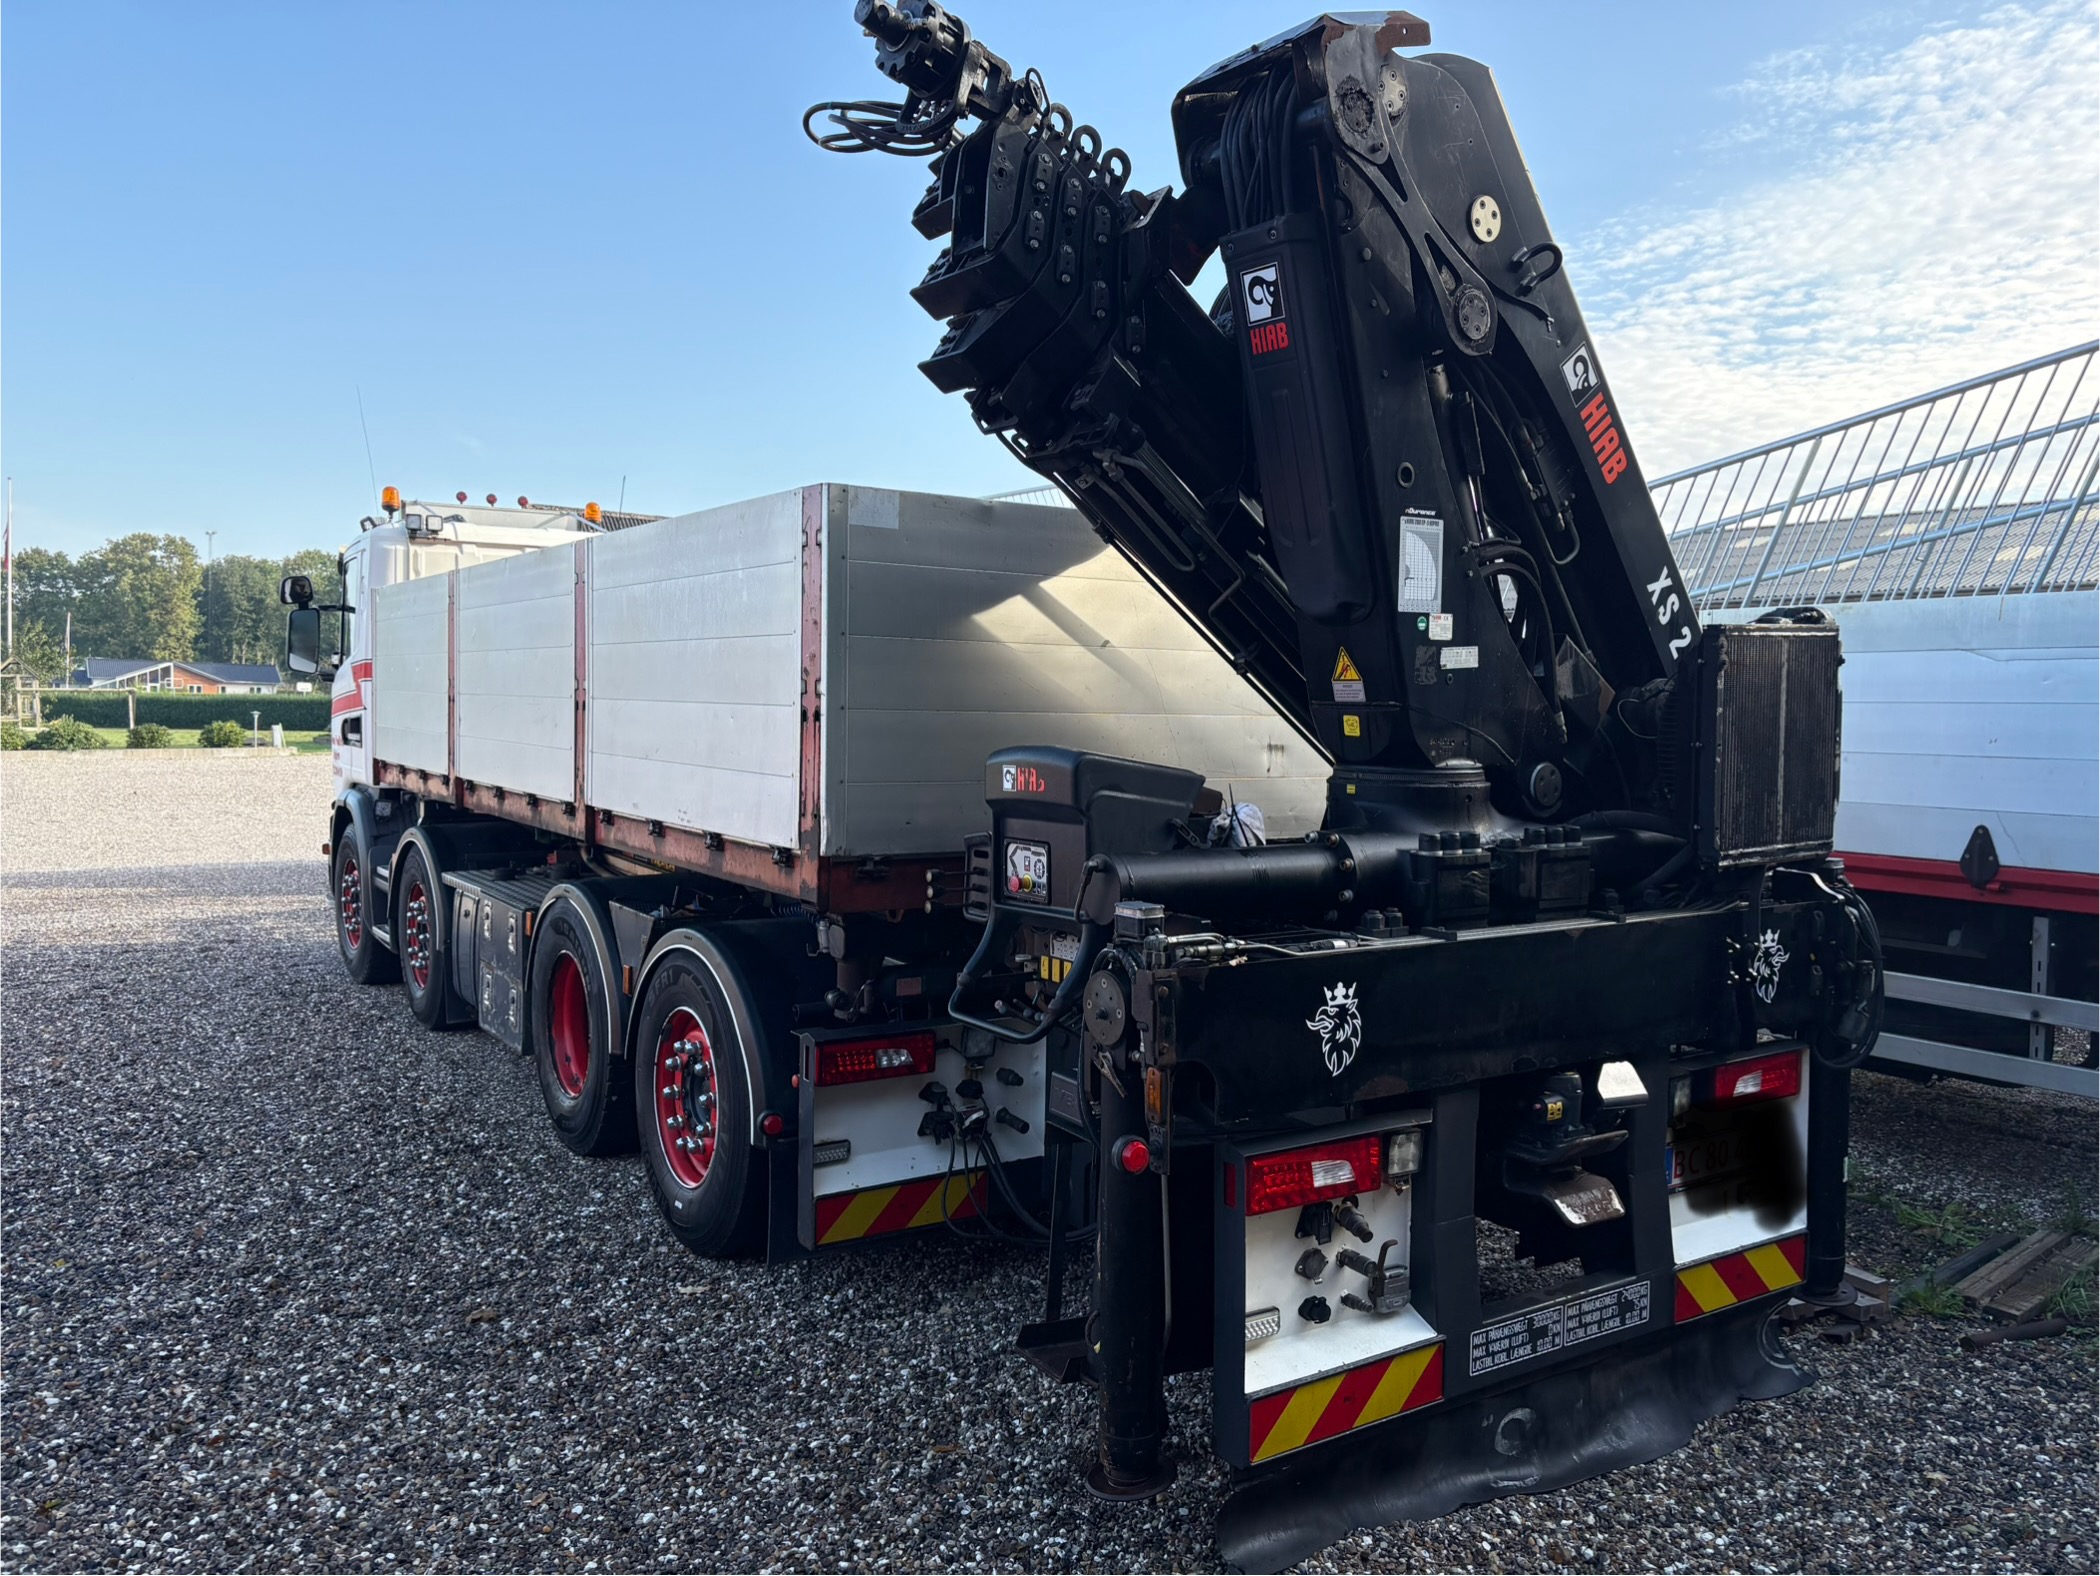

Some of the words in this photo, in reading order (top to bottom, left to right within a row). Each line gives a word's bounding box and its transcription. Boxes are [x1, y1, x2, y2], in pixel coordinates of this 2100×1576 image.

[1250, 322, 1289, 355] HIAB
[1580, 391, 1628, 484] HIAB
[1646, 565, 1680, 625] XS
[1668, 626, 1692, 660] 2
[1674, 1145, 1700, 1178] BC
[1706, 1140, 1728, 1170] 80
[1567, 1304, 1580, 1317] MAX
[1567, 1317, 1580, 1329] MAX
[1473, 1332, 1486, 1346] MAX
[1473, 1345, 1486, 1359] MAX
[1473, 1355, 1493, 1371] LASTBIL
